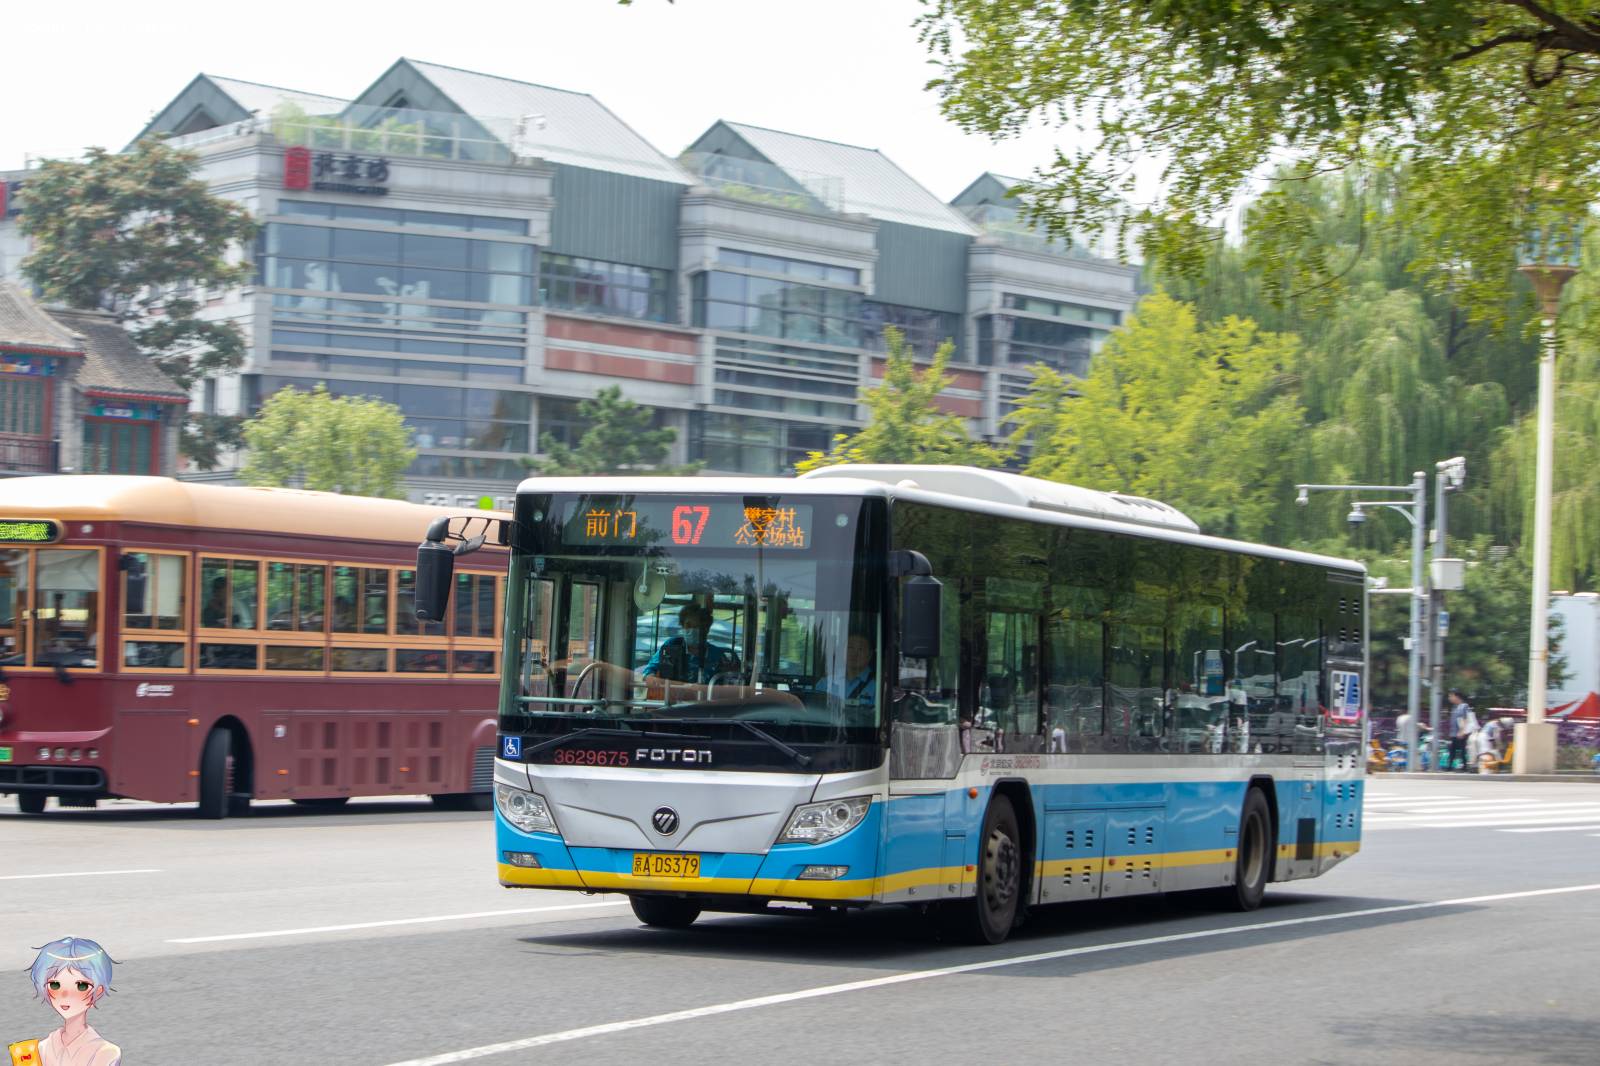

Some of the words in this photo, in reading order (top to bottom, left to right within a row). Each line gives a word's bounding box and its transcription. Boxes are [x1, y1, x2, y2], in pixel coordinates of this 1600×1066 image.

[585, 508, 638, 539] 前门
[671, 505, 710, 545] 67
[743, 507, 797, 529] 樊家村
[734, 524, 805, 547] 公交场站
[554, 749, 630, 766] 3629675
[635, 748, 713, 763] FOTON
